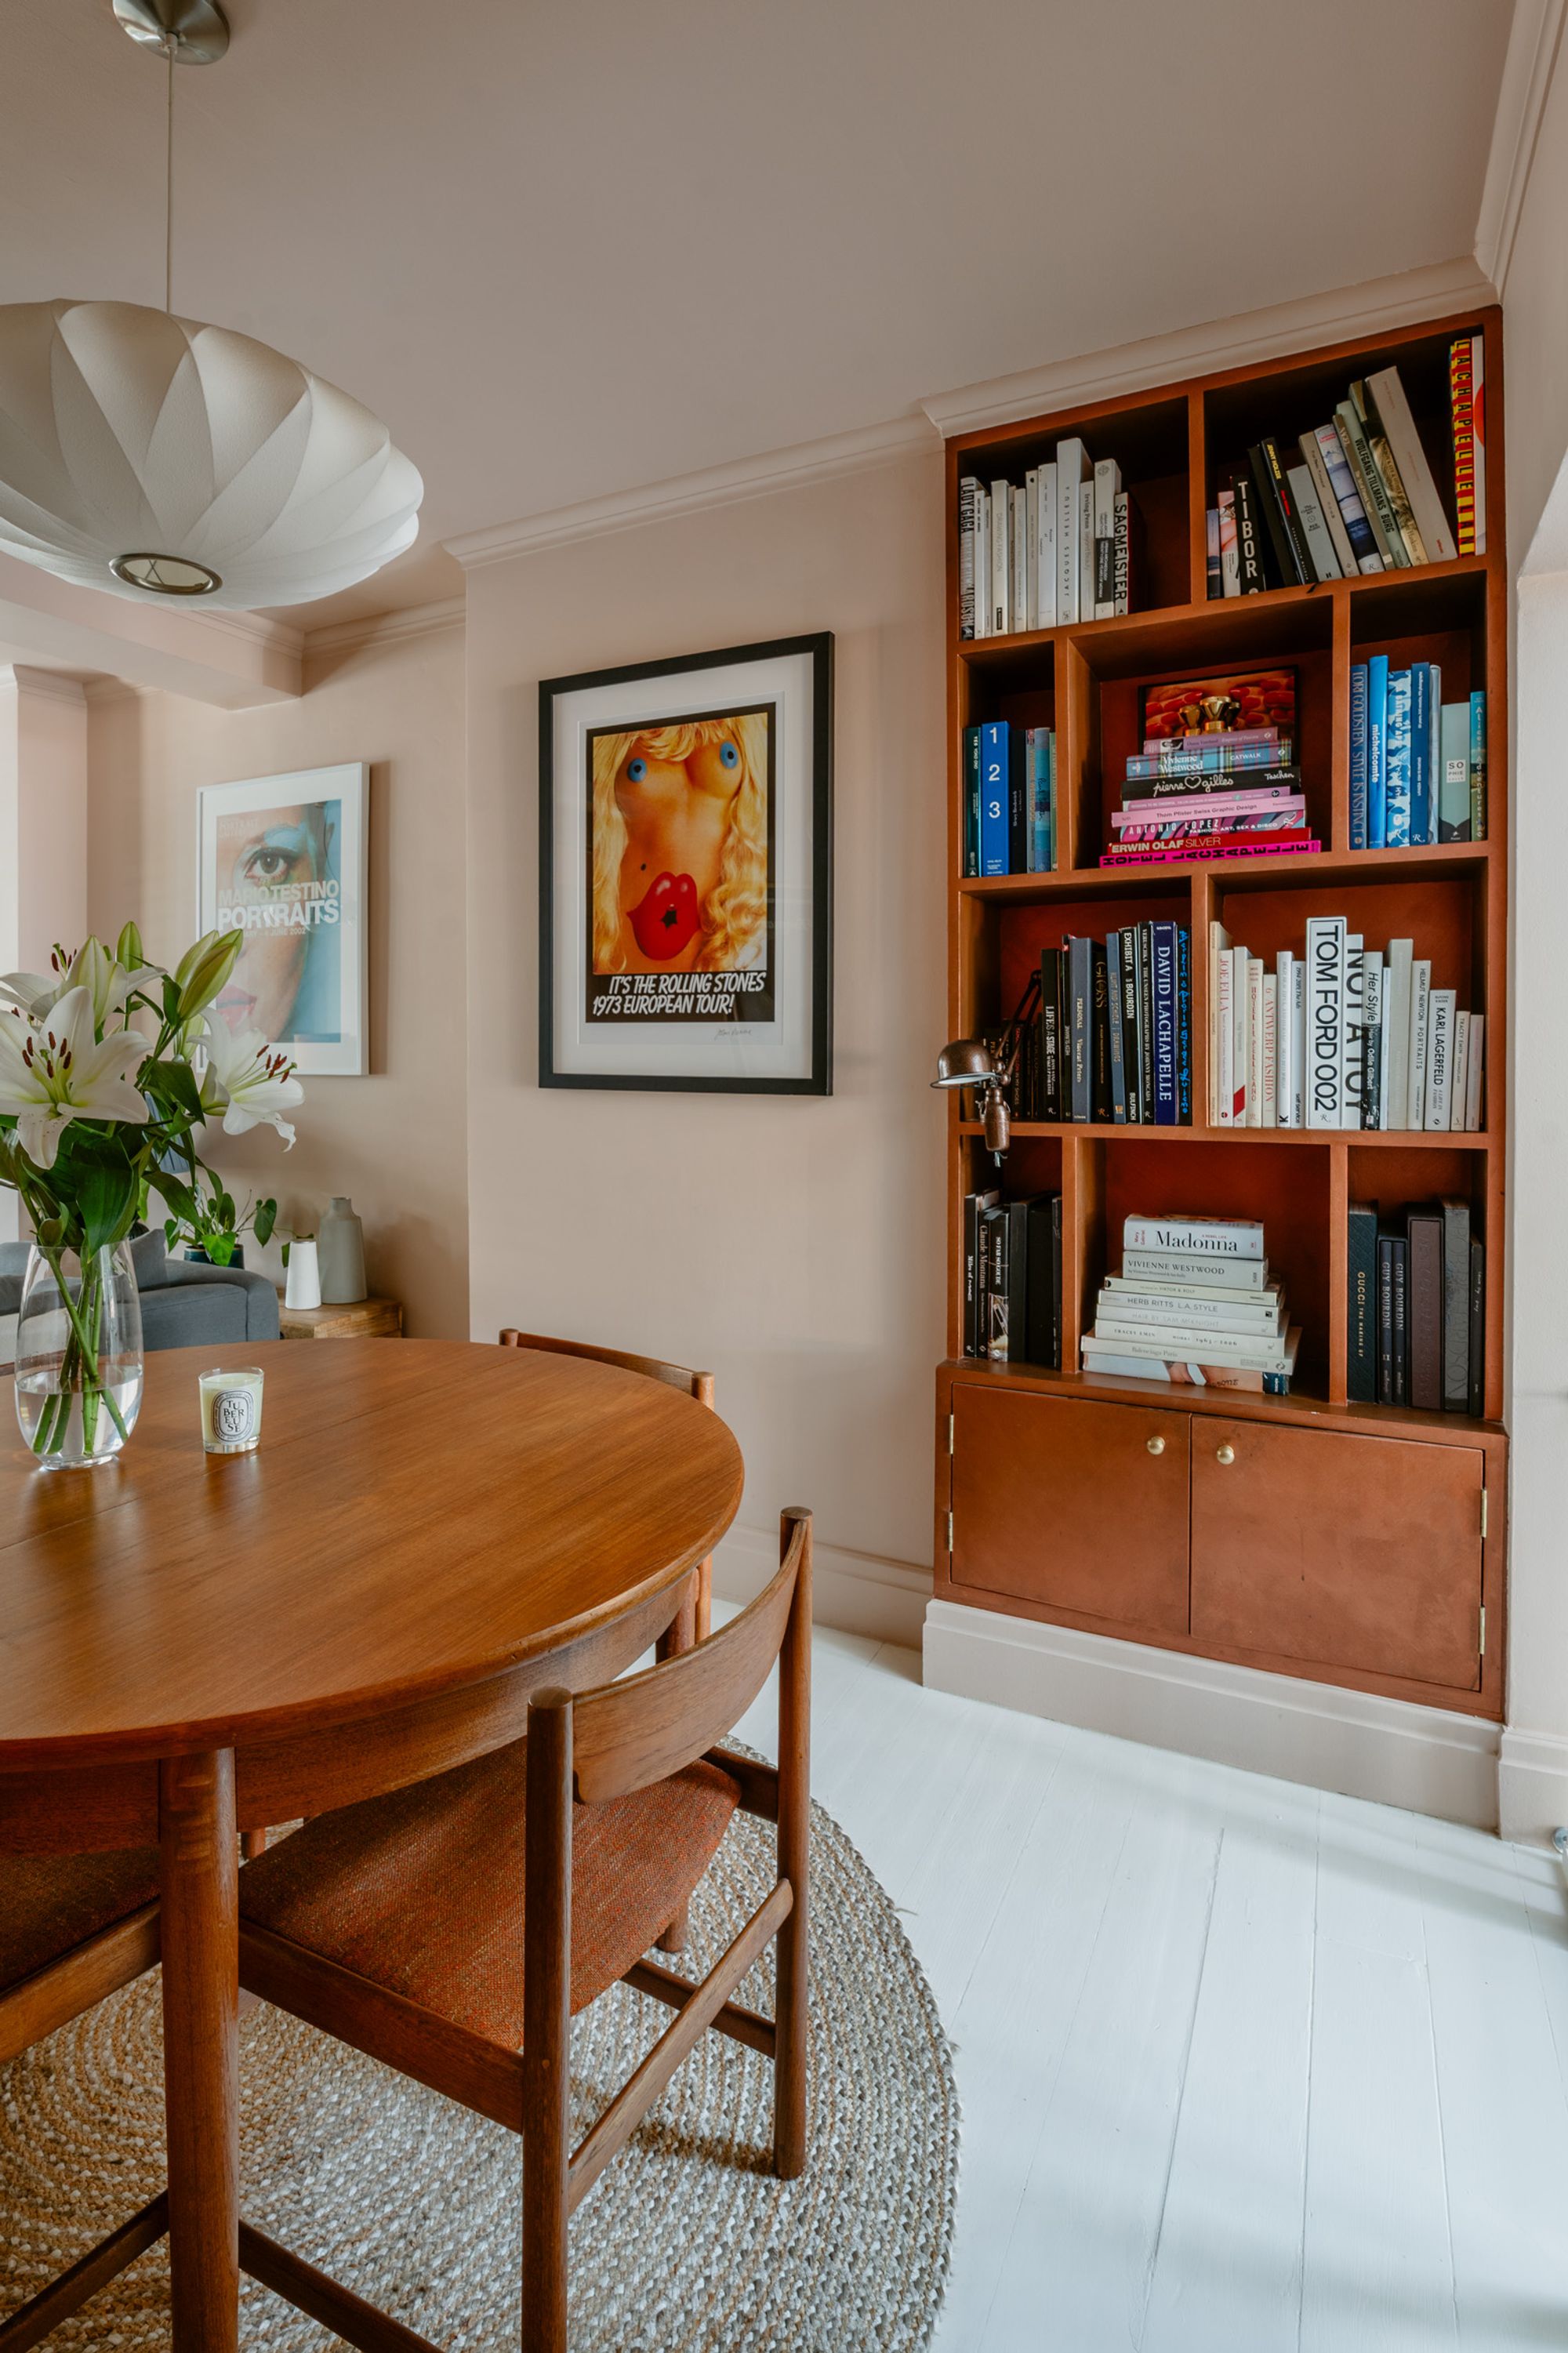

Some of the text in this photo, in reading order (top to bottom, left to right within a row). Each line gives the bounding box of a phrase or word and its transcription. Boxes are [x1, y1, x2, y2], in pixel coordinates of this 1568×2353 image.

[1456, 340, 1473, 490] LACHAPELLE
[1355, 438, 1374, 477] WOLFGANG
[1367, 473, 1386, 511] TILLMANS
[1381, 513, 1395, 534] BURG
[961, 483, 975, 534] LADY GAGA
[1237, 481, 1258, 579] TIBOR
[1115, 503, 1127, 601] SAGMEISTER
[1352, 671, 1364, 693] LORI
[989, 727, 997, 744] 1
[1162, 755, 1198, 765] Vivienne
[1230, 752, 1261, 761] CATWALK
[1352, 750, 1364, 779] STYLE
[1372, 724, 1382, 783] michelcomte
[989, 764, 1000, 782] 2
[1158, 761, 1203, 773] Westwood
[1264, 770, 1295, 781] Taschen
[1152, 774, 1234, 798] pierre gilles
[989, 801, 1000, 819] 3
[1129, 819, 1218, 835] ANTONIO LOPEZ
[1103, 843, 1309, 866] HOTEL LACHAPELLE
[1112, 837, 1221, 853] ERWIN OLAF SILVER
[219, 879, 340, 907] MARIO TESTINO
[218, 899, 339, 931] PORTRAITS
[289, 927, 307, 935] 2002
[1123, 931, 1133, 964] EXHIBIT
[1220, 958, 1229, 979] JOE
[609, 971, 767, 994] IT'S THE ROLLING STONES
[593, 994, 734, 1017] 1973 EUROPEAN TOUR!
[1125, 982, 1135, 1019] BOURDIN
[1367, 972, 1378, 1022] Her Style
[1157, 946, 1172, 1101] DAVID LACHAPELLE
[1265, 999, 1274, 1053] ANTWERP
[1315, 925, 1339, 1112] TOM FORD 002
[1345, 1022, 1363, 1044] A
[1046, 1036, 1055, 1055] STAGE
[1434, 1007, 1446, 1086] KARL LAGERFELD
[1265, 1055, 1274, 1102] FASHION
[1155, 1230, 1239, 1252] Madonna
[979, 1225, 988, 1289] Claude Montana
[1128, 1260, 1225, 1275] VIVIENNE WESTWOOD
[1357, 1271, 1366, 1305] GUCCI
[1382, 1262, 1391, 1329] GUY BOURDIN
[1127, 1297, 1149, 1305] HERB
[1152, 1299, 1174, 1308] RITTS
[1193, 1303, 1218, 1313] STYLE
[223, 1408, 245, 1418] BER
[227, 1400, 241, 1410] TU
[225, 1416, 241, 1425] EU
[227, 1424, 241, 1432] SE
